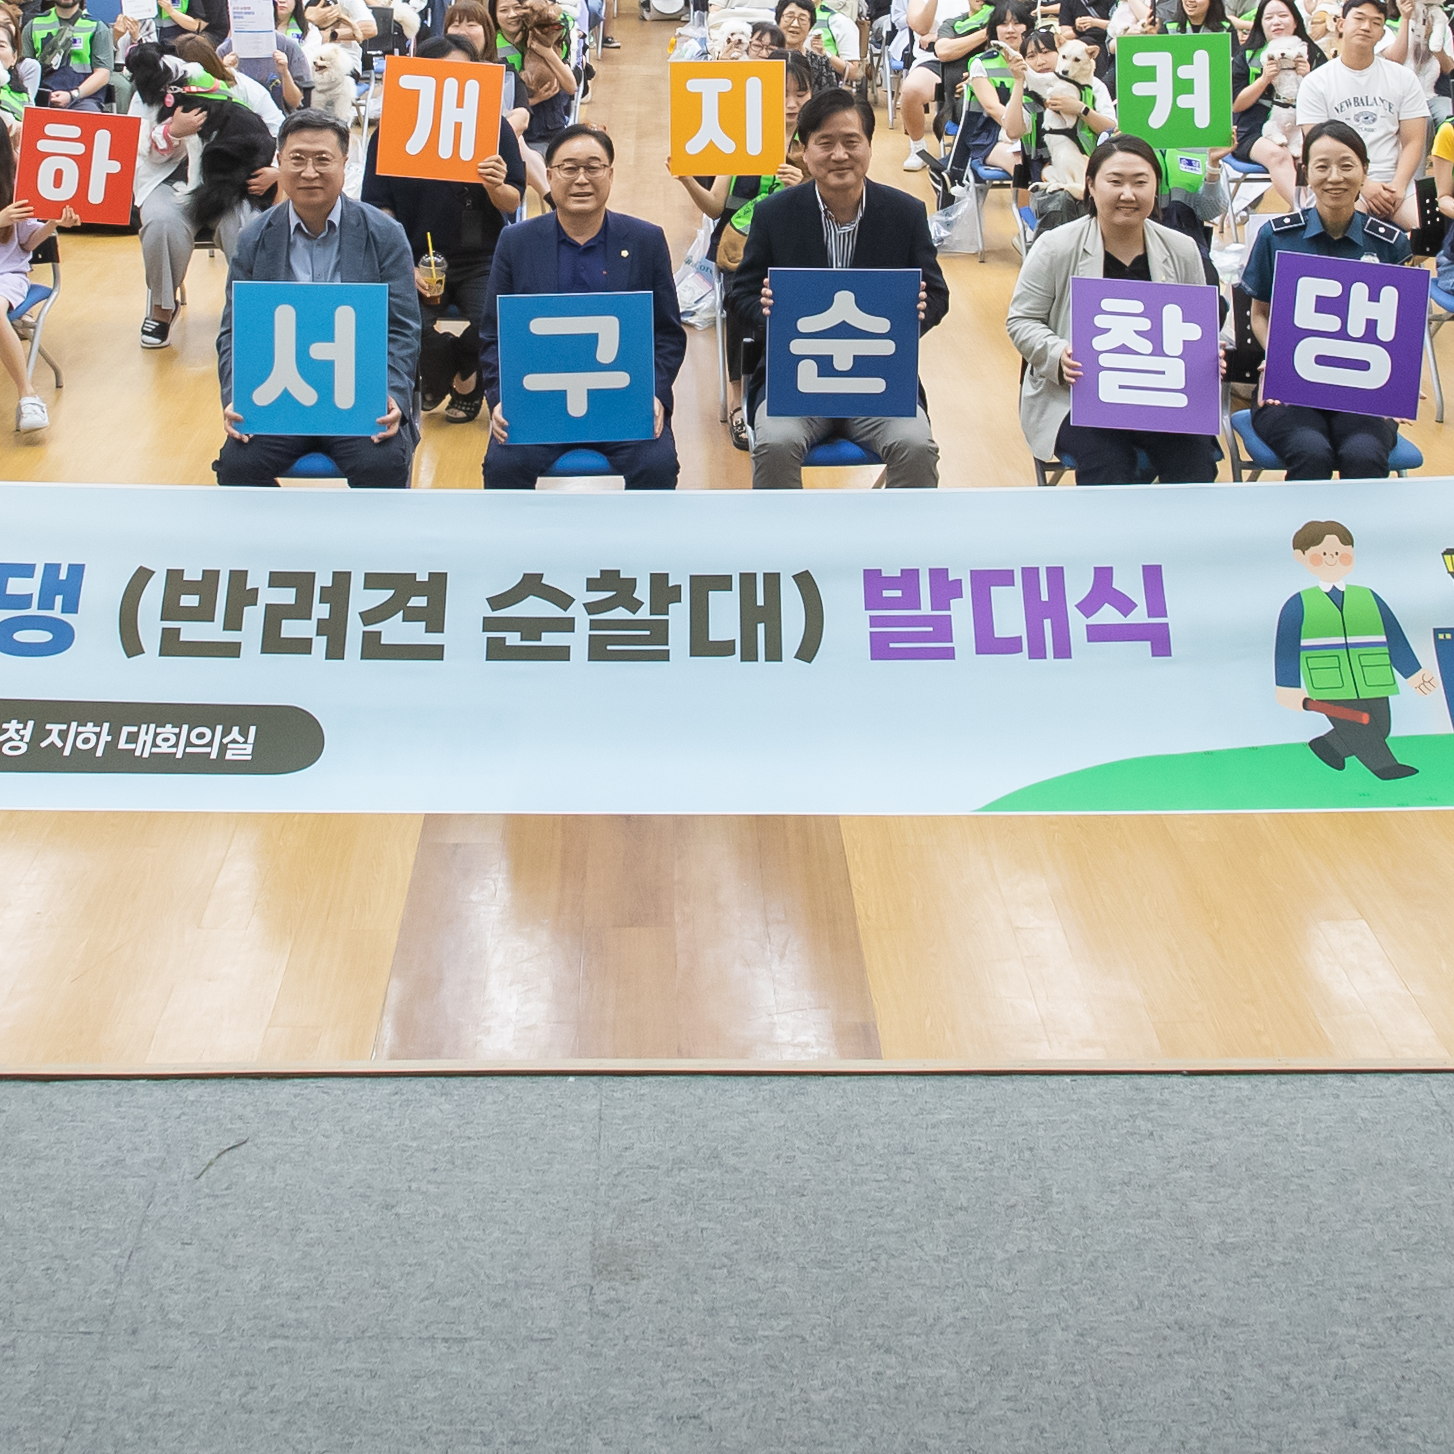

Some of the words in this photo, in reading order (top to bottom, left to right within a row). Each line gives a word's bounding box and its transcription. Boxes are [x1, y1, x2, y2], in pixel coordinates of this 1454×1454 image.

[398, 74, 480, 162] 개
[685, 76, 763, 156] 지
[1131, 49, 1211, 129] 켜
[36, 123, 122, 205] 하
[252, 304, 356, 409] 서
[522, 315, 630, 417] 구
[789, 290, 896, 394] 순
[1091, 298, 1203, 408] 찰
[1293, 276, 1399, 390] 댕
[119, 565, 448, 661] (반려견
[481, 569, 825, 664] 순찰대)
[862, 564, 1173, 661] 발대식
[39, 722, 112, 758] 지하
[117, 723, 257, 761] 대회의실
